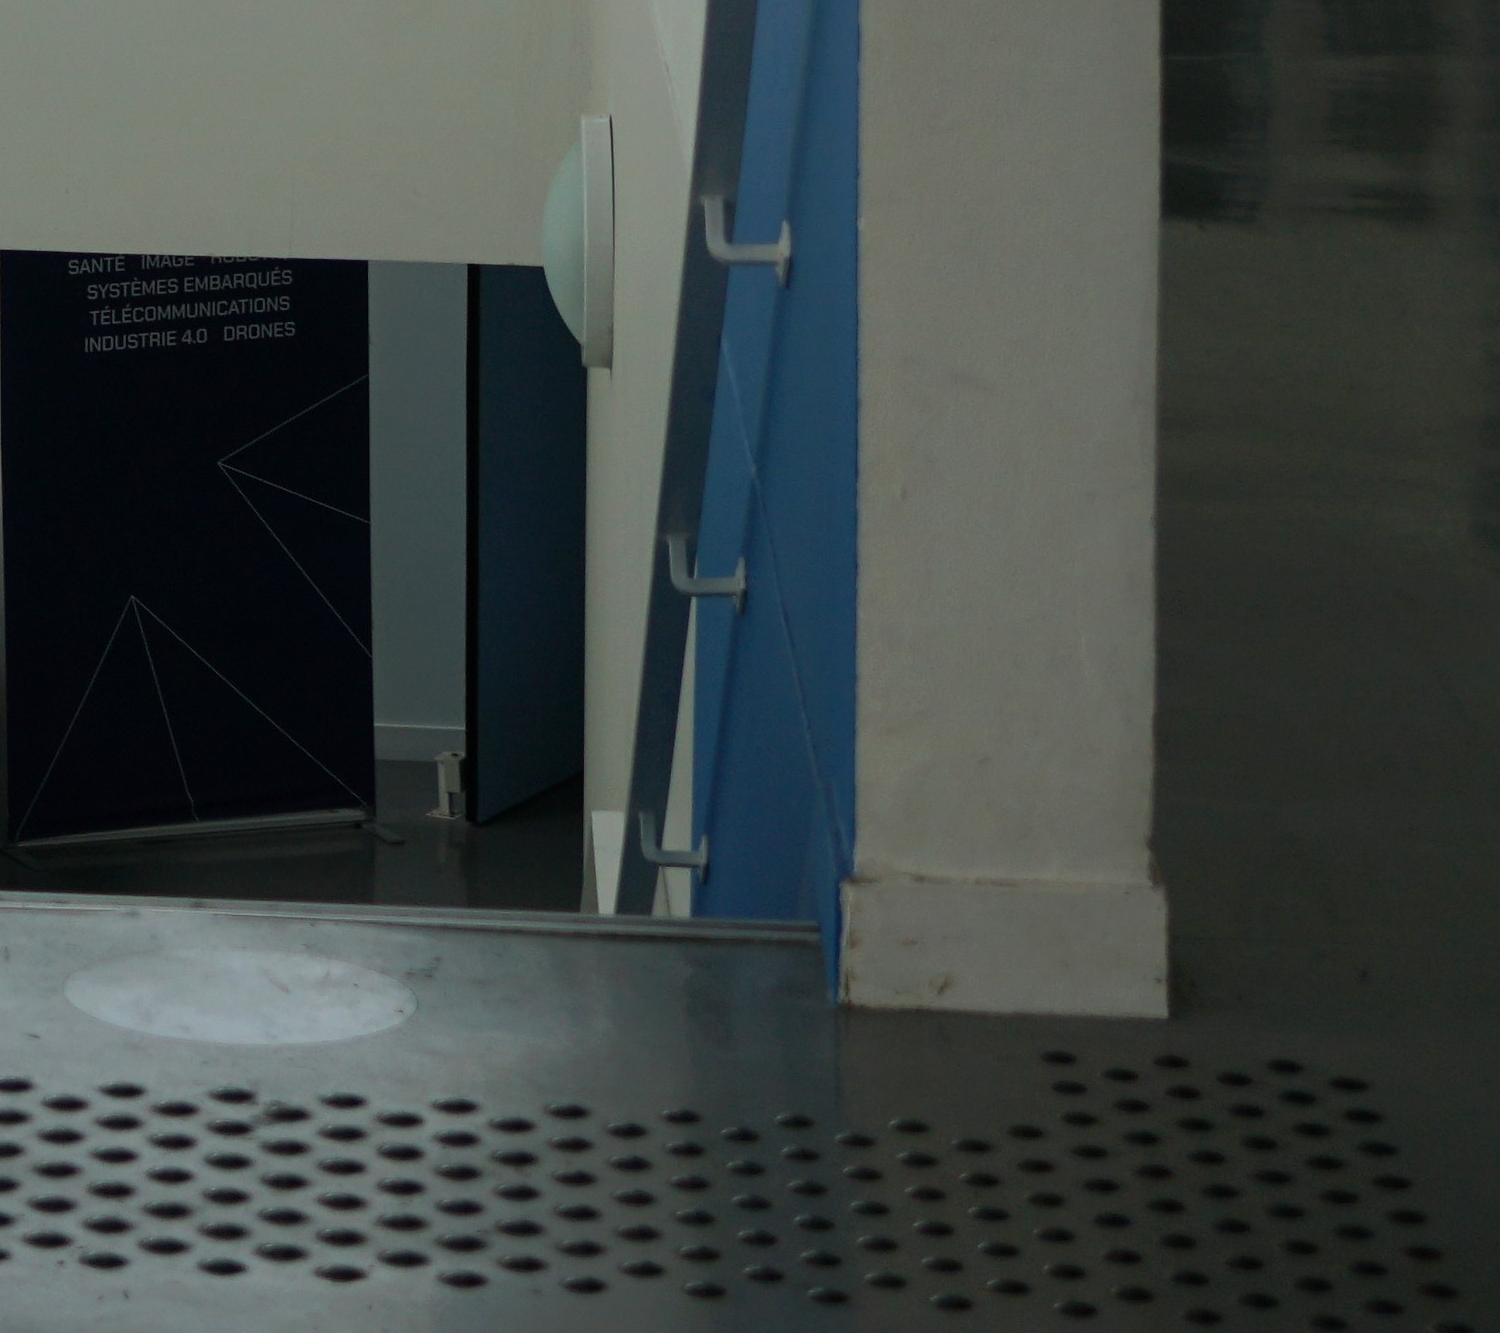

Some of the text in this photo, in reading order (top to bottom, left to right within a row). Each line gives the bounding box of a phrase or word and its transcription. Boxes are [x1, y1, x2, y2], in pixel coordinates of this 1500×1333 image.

[86, 266, 293, 301] SYSTÈMES EMBARQUÉS
[89, 295, 291, 326] TÉLÉCOMMUNICATIONS
[83, 321, 296, 353] INDUSTRIE 4.0 DRONES
